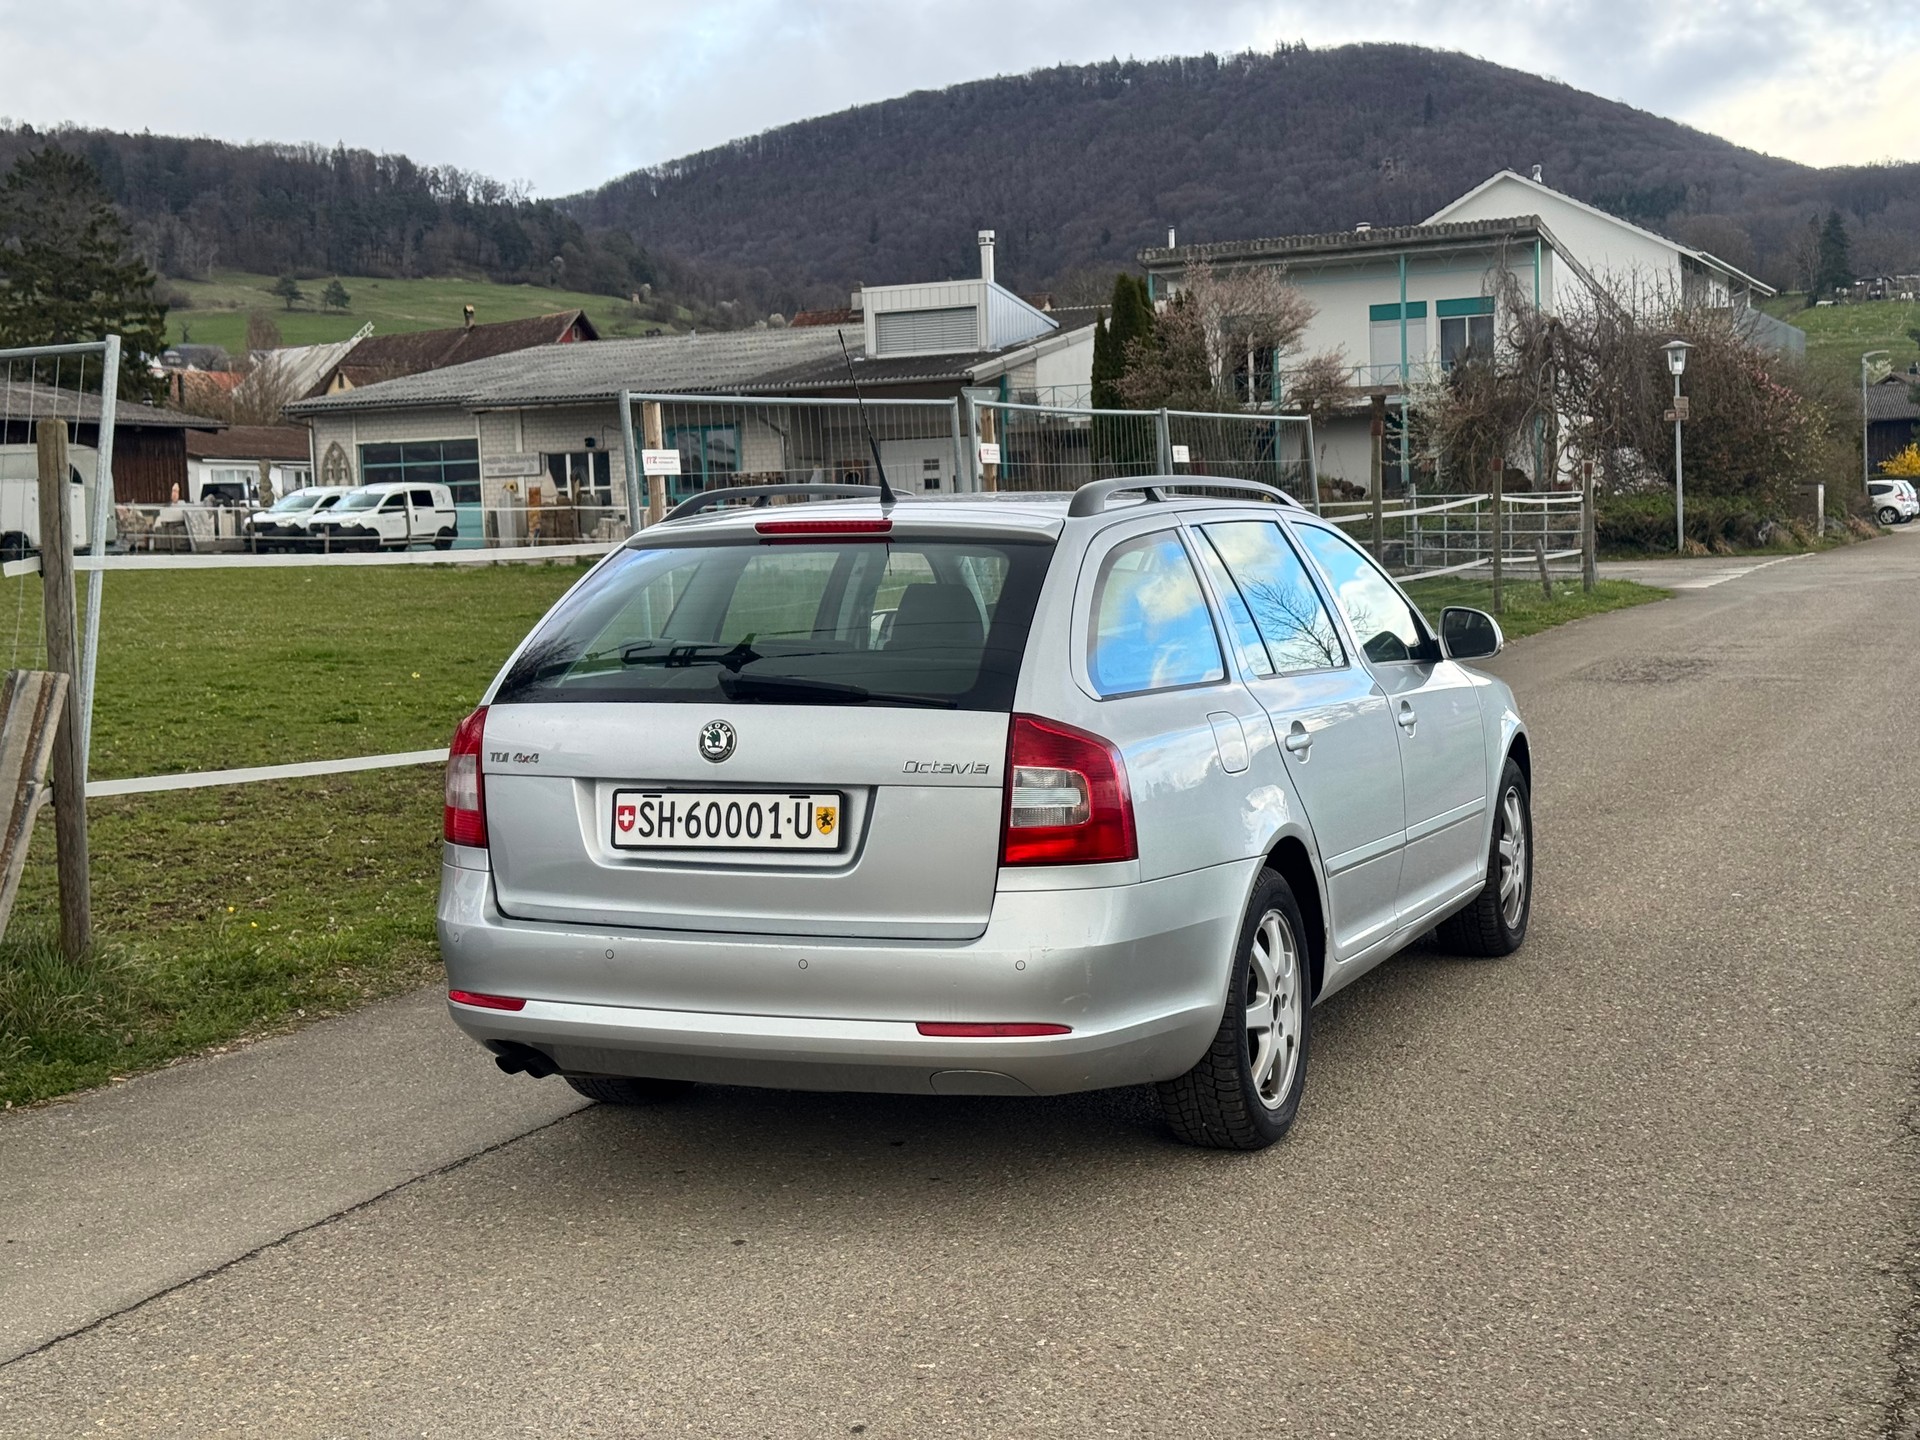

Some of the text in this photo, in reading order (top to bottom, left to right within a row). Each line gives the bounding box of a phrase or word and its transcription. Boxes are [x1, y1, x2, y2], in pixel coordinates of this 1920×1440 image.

[489, 751, 540, 764] TDI 4x4
[902, 760, 990, 775] Octavia
